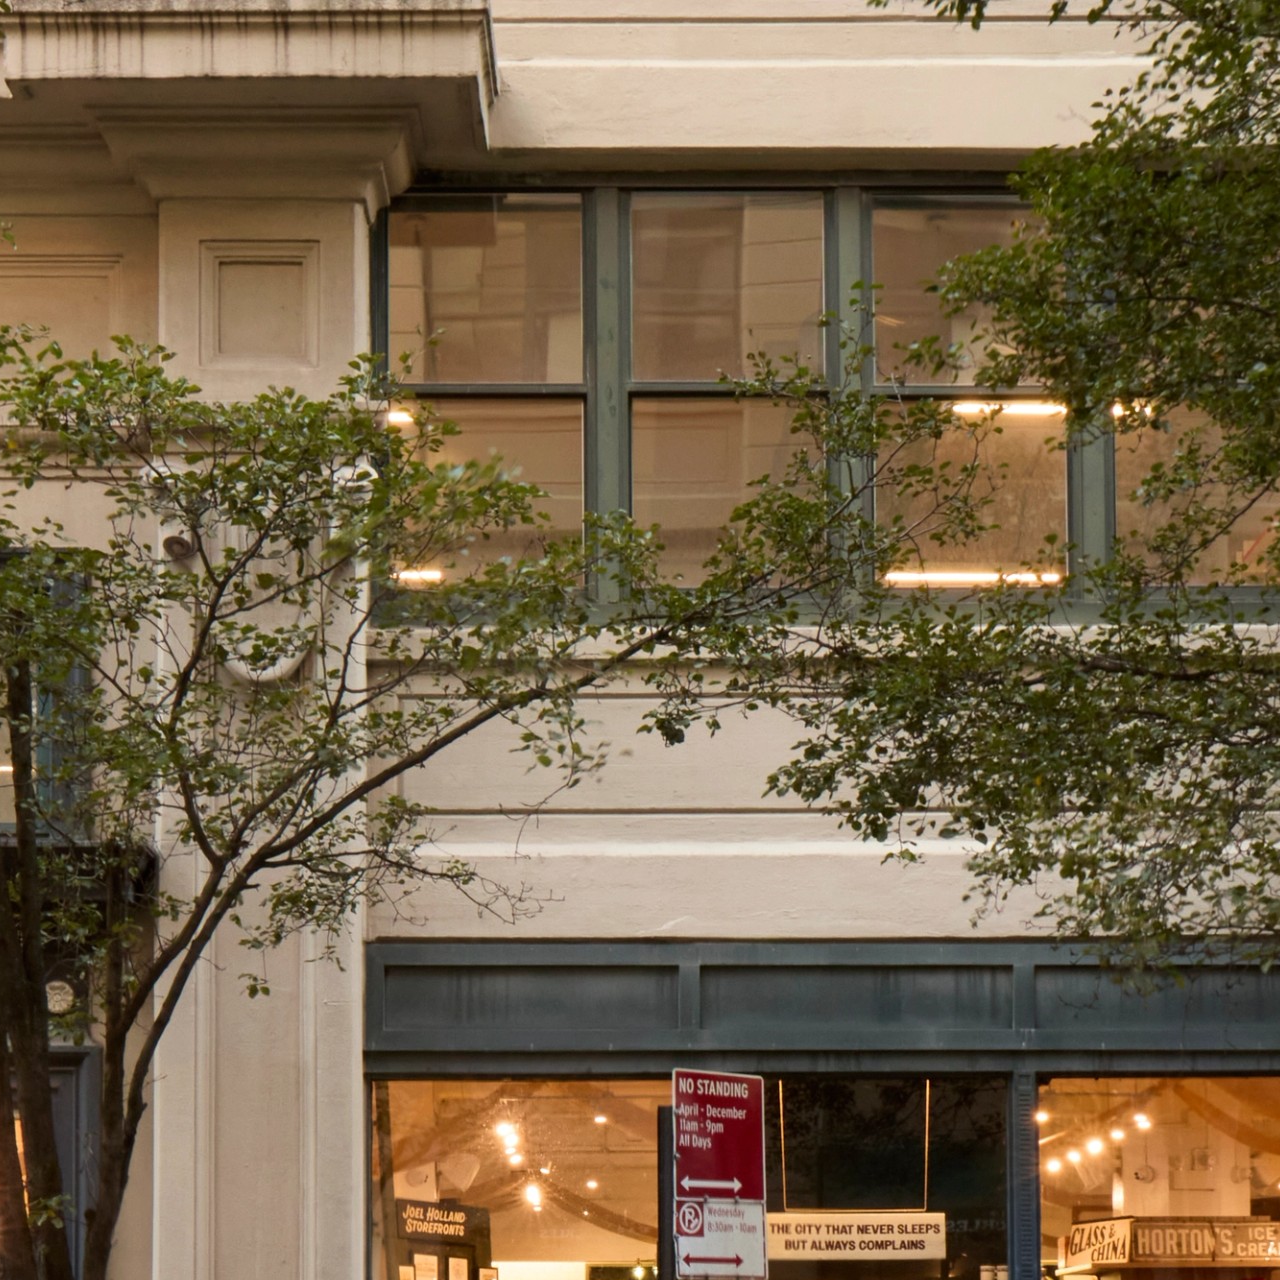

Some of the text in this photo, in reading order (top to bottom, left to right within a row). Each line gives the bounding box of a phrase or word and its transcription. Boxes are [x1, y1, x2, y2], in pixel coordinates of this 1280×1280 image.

[679, 1078, 749, 1099] NO STANDING
[679, 1103, 699, 1117] April
[706, 1104, 747, 1120] December
[680, 1118, 699, 1131] 11am
[706, 1119, 724, 1134] 9pm
[679, 1134, 712, 1150] All Days
[403, 1205, 466, 1222] JOEL HOLLAND
[707, 1207, 745, 1219] Wednesday
[406, 1219, 465, 1237] STOREFRONTS
[707, 1222, 733, 1232] 8:30am
[740, 1223, 756, 1232] 10am
[770, 1223, 791, 1234] THE
[794, 1223, 820, 1235] CITY
[825, 1224, 854, 1235] THAT
[856, 1224, 894, 1235] NEVER
[897, 1224, 940, 1234] SLEEPS
[1248, 1227, 1277, 1241] ICE
[784, 1240, 926, 1250] BUT ALWAYS COMPLAINS
[1070, 1225, 1107, 1256] GLASS
[1091, 1233, 1127, 1262] CHINA
